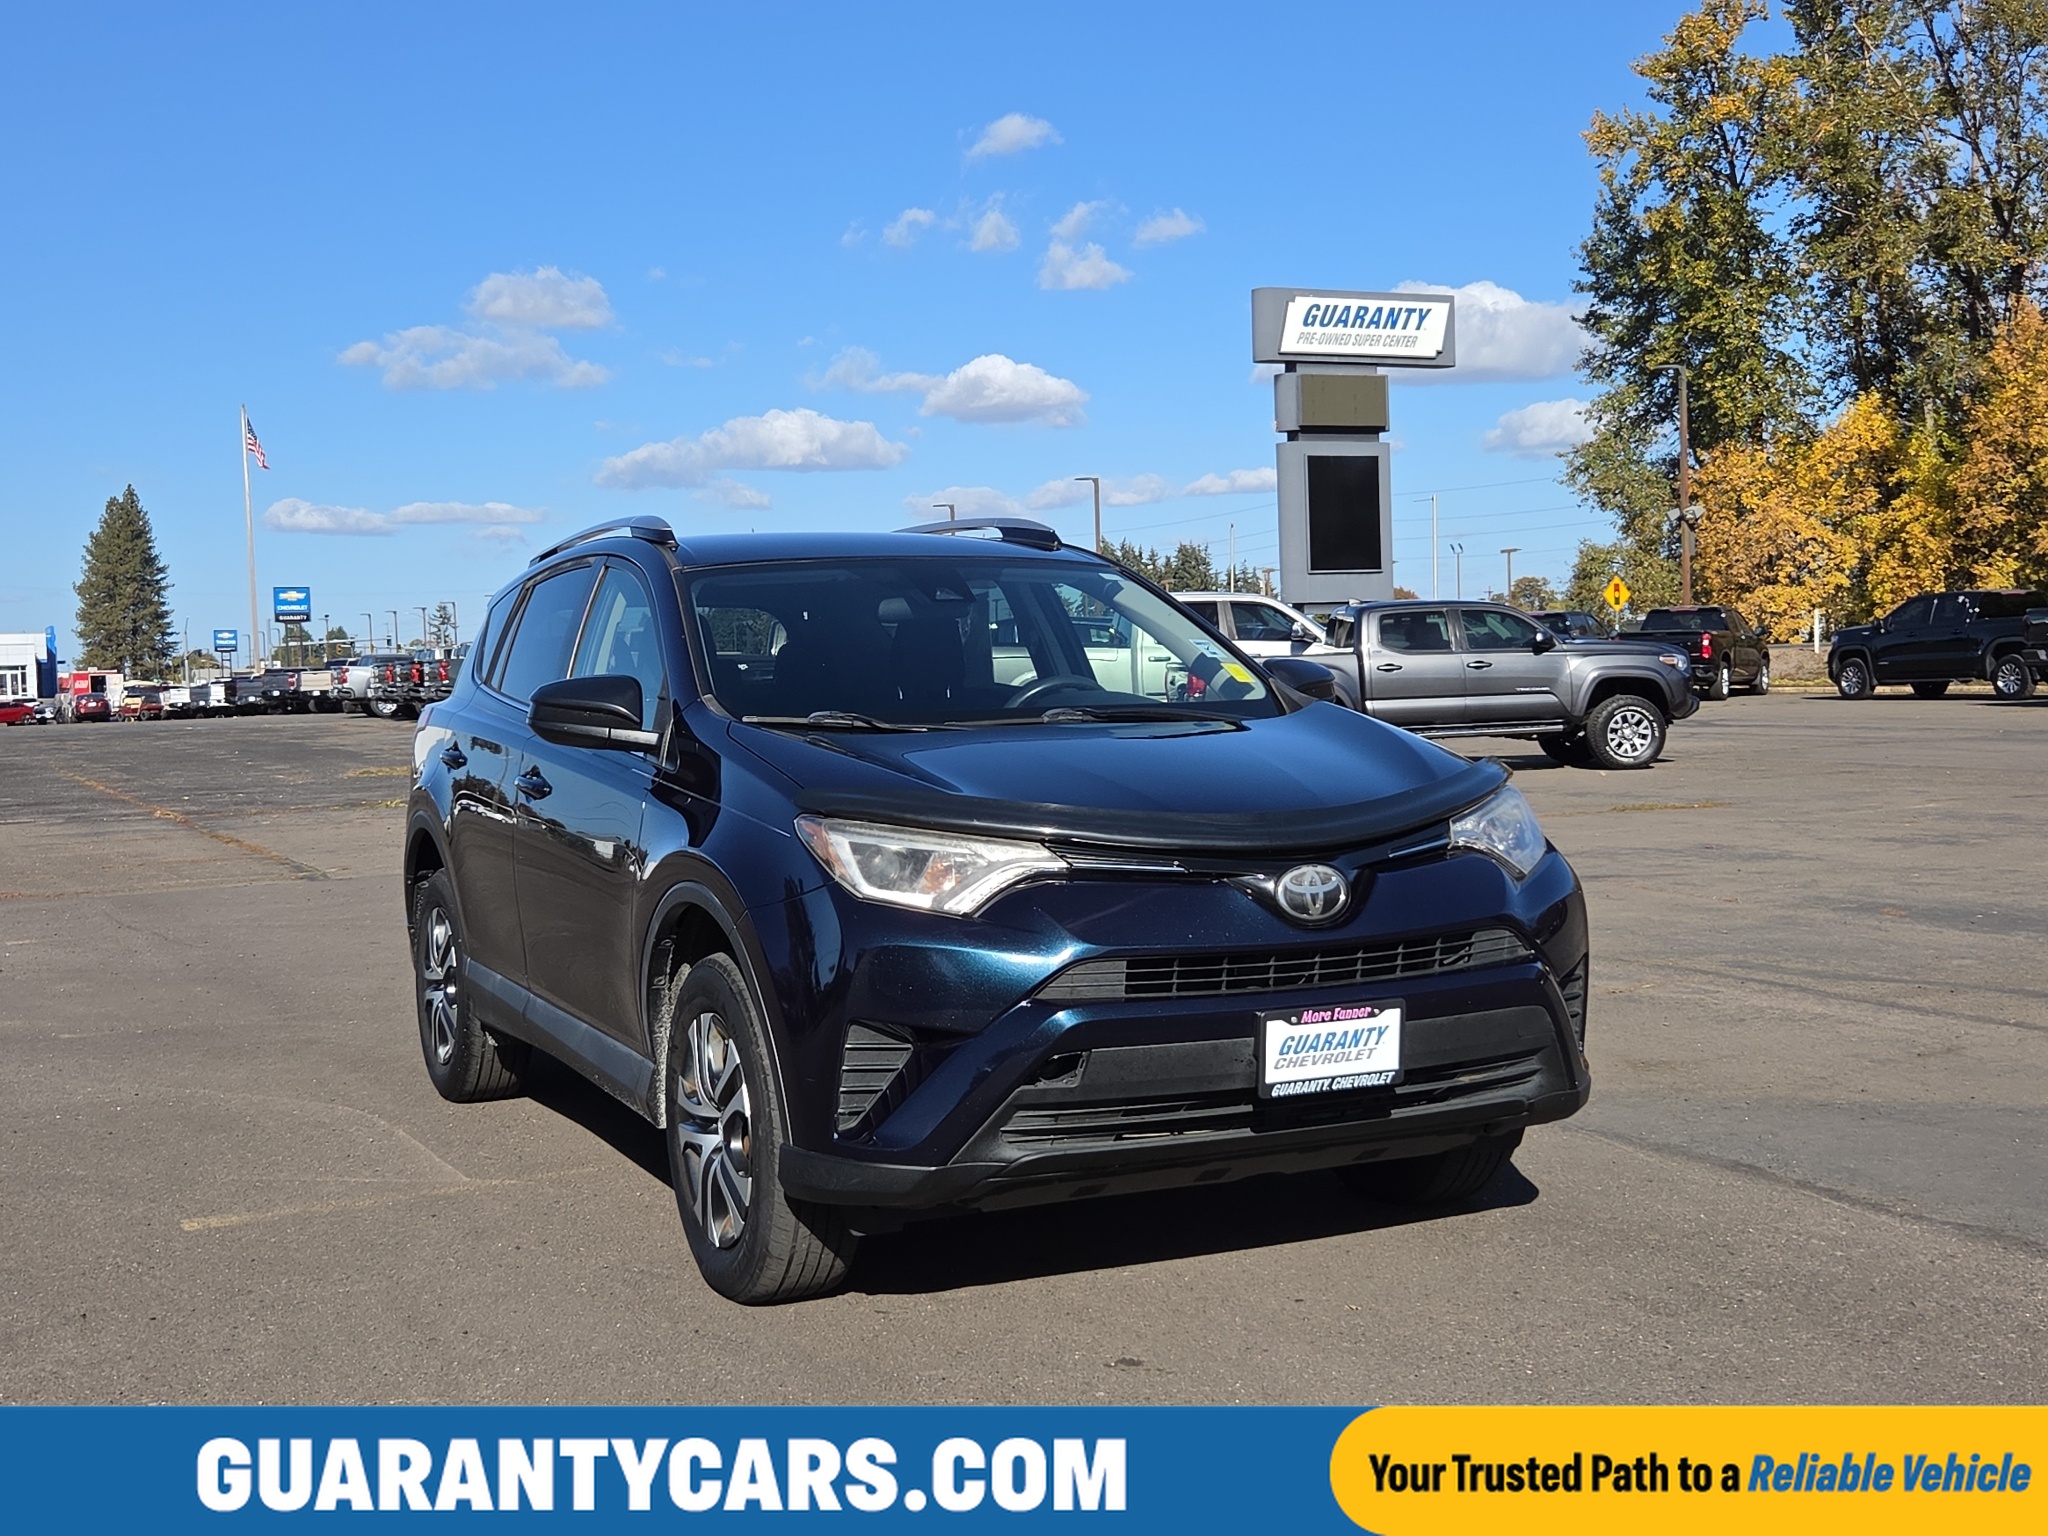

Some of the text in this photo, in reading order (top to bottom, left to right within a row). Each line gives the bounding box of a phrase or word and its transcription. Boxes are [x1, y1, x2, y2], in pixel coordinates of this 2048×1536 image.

[1302, 303, 1432, 331] GUARANTY
[1296, 332, 1418, 348] PRE-OWNED SUPER CENTER
[1300, 1009, 1332, 1023] More
[1278, 1025, 1390, 1056] GUARANTY
[1273, 1047, 1377, 1070] CHEVROLET
[1331, 1071, 1396, 1090] CHEVROLET
